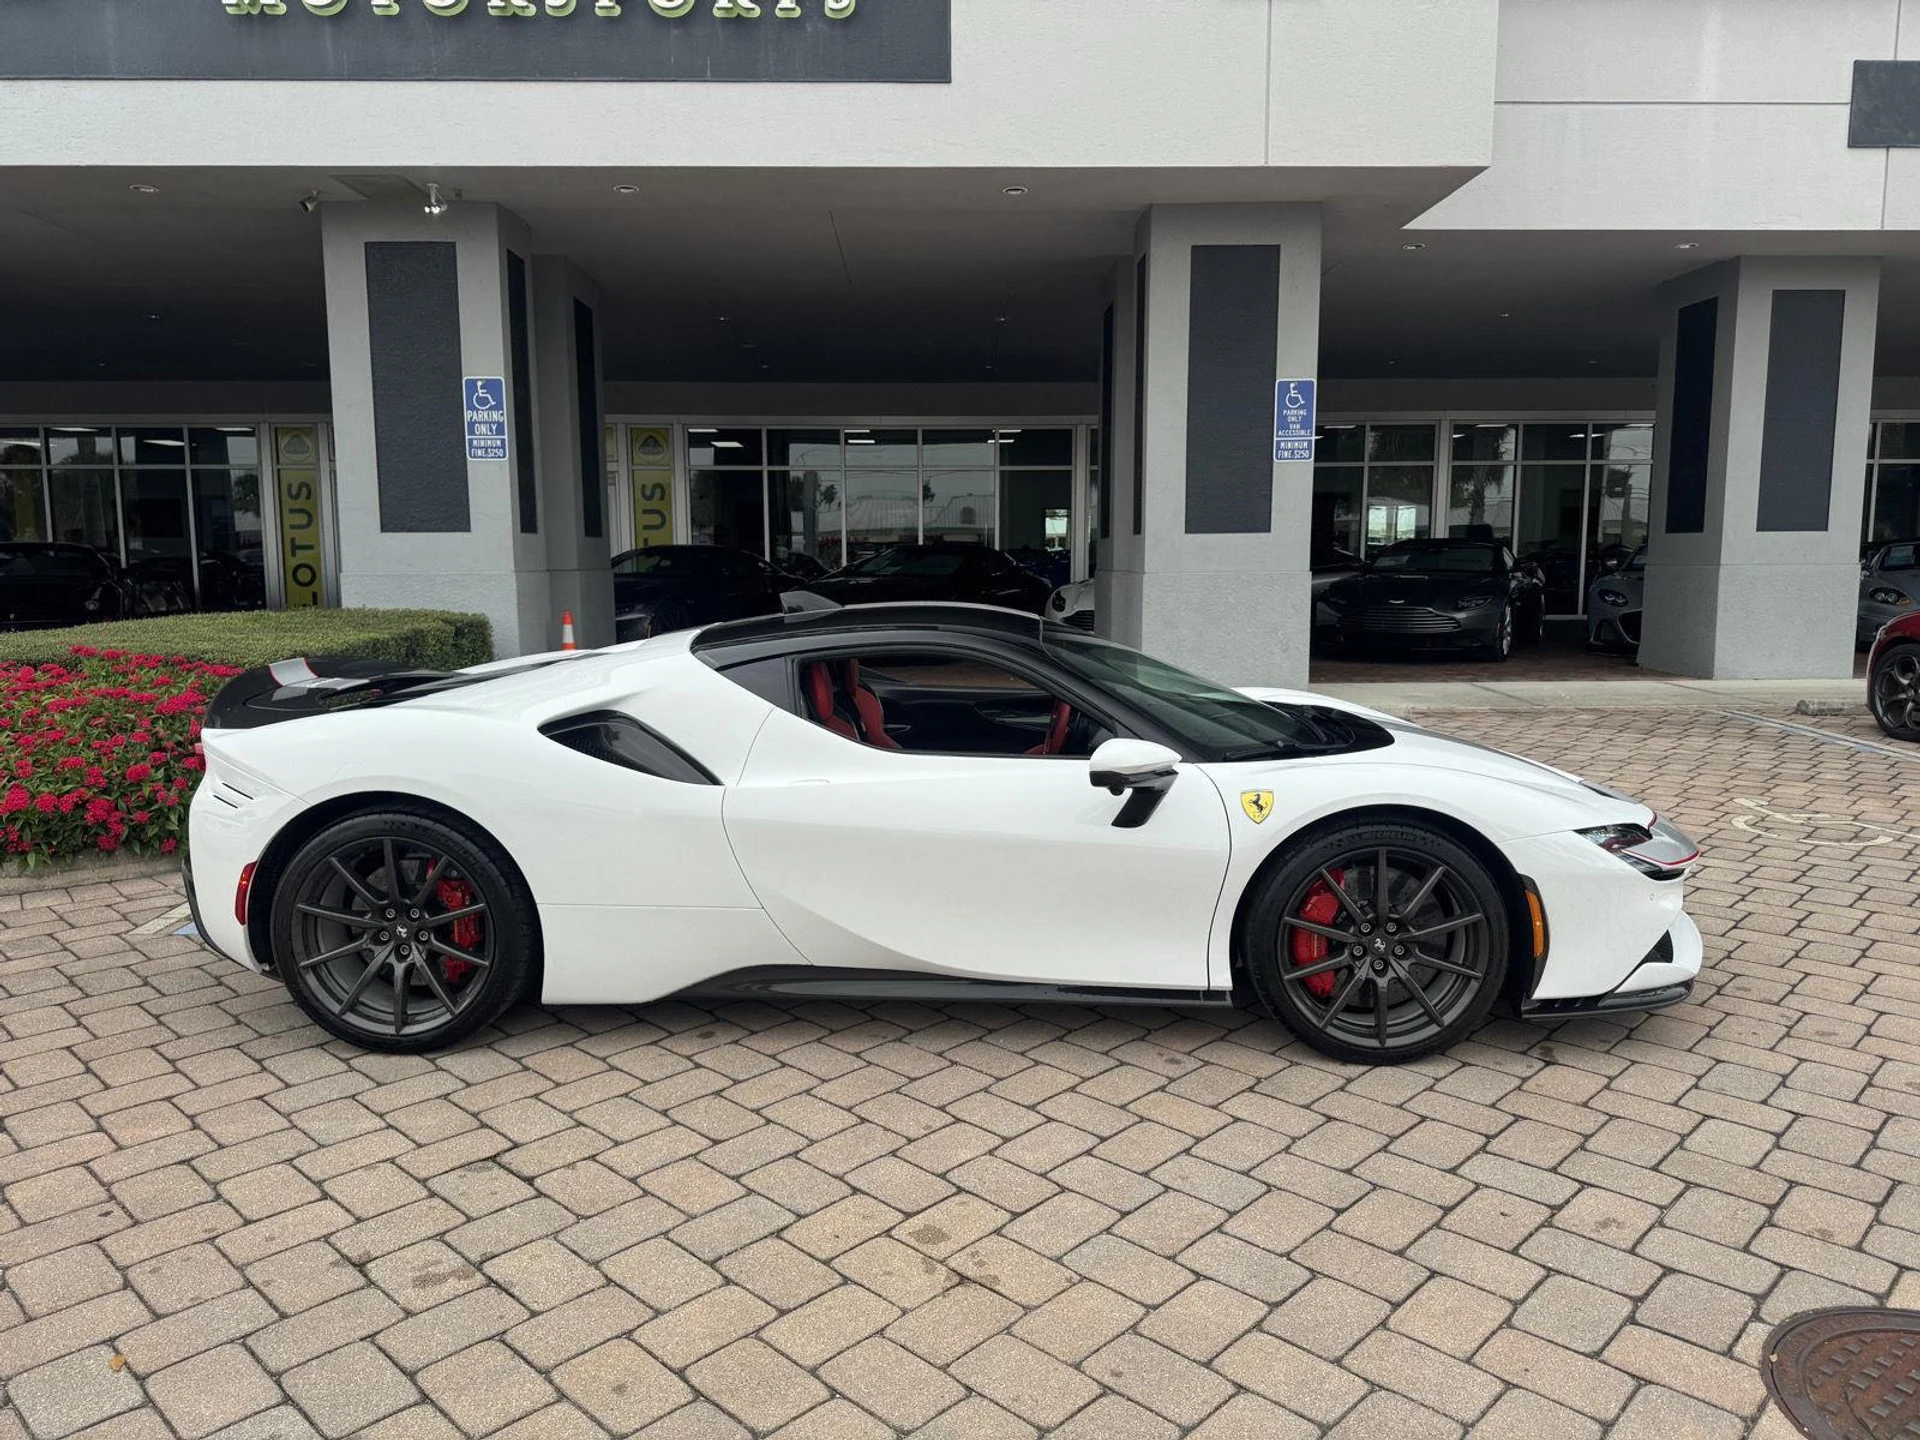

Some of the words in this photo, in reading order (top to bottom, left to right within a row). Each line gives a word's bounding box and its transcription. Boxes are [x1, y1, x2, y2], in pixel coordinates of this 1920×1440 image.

[467, 411, 504, 422] PARKING
[474, 423, 498, 435] ONLY
[472, 439, 501, 447] MINIMUM
[1280, 441, 1308, 449] MINIMUM
[471, 448, 486, 457] FINE
[486, 448, 504, 457] $250
[1277, 450, 1293, 459] FINE
[1293, 450, 1310, 458] $250
